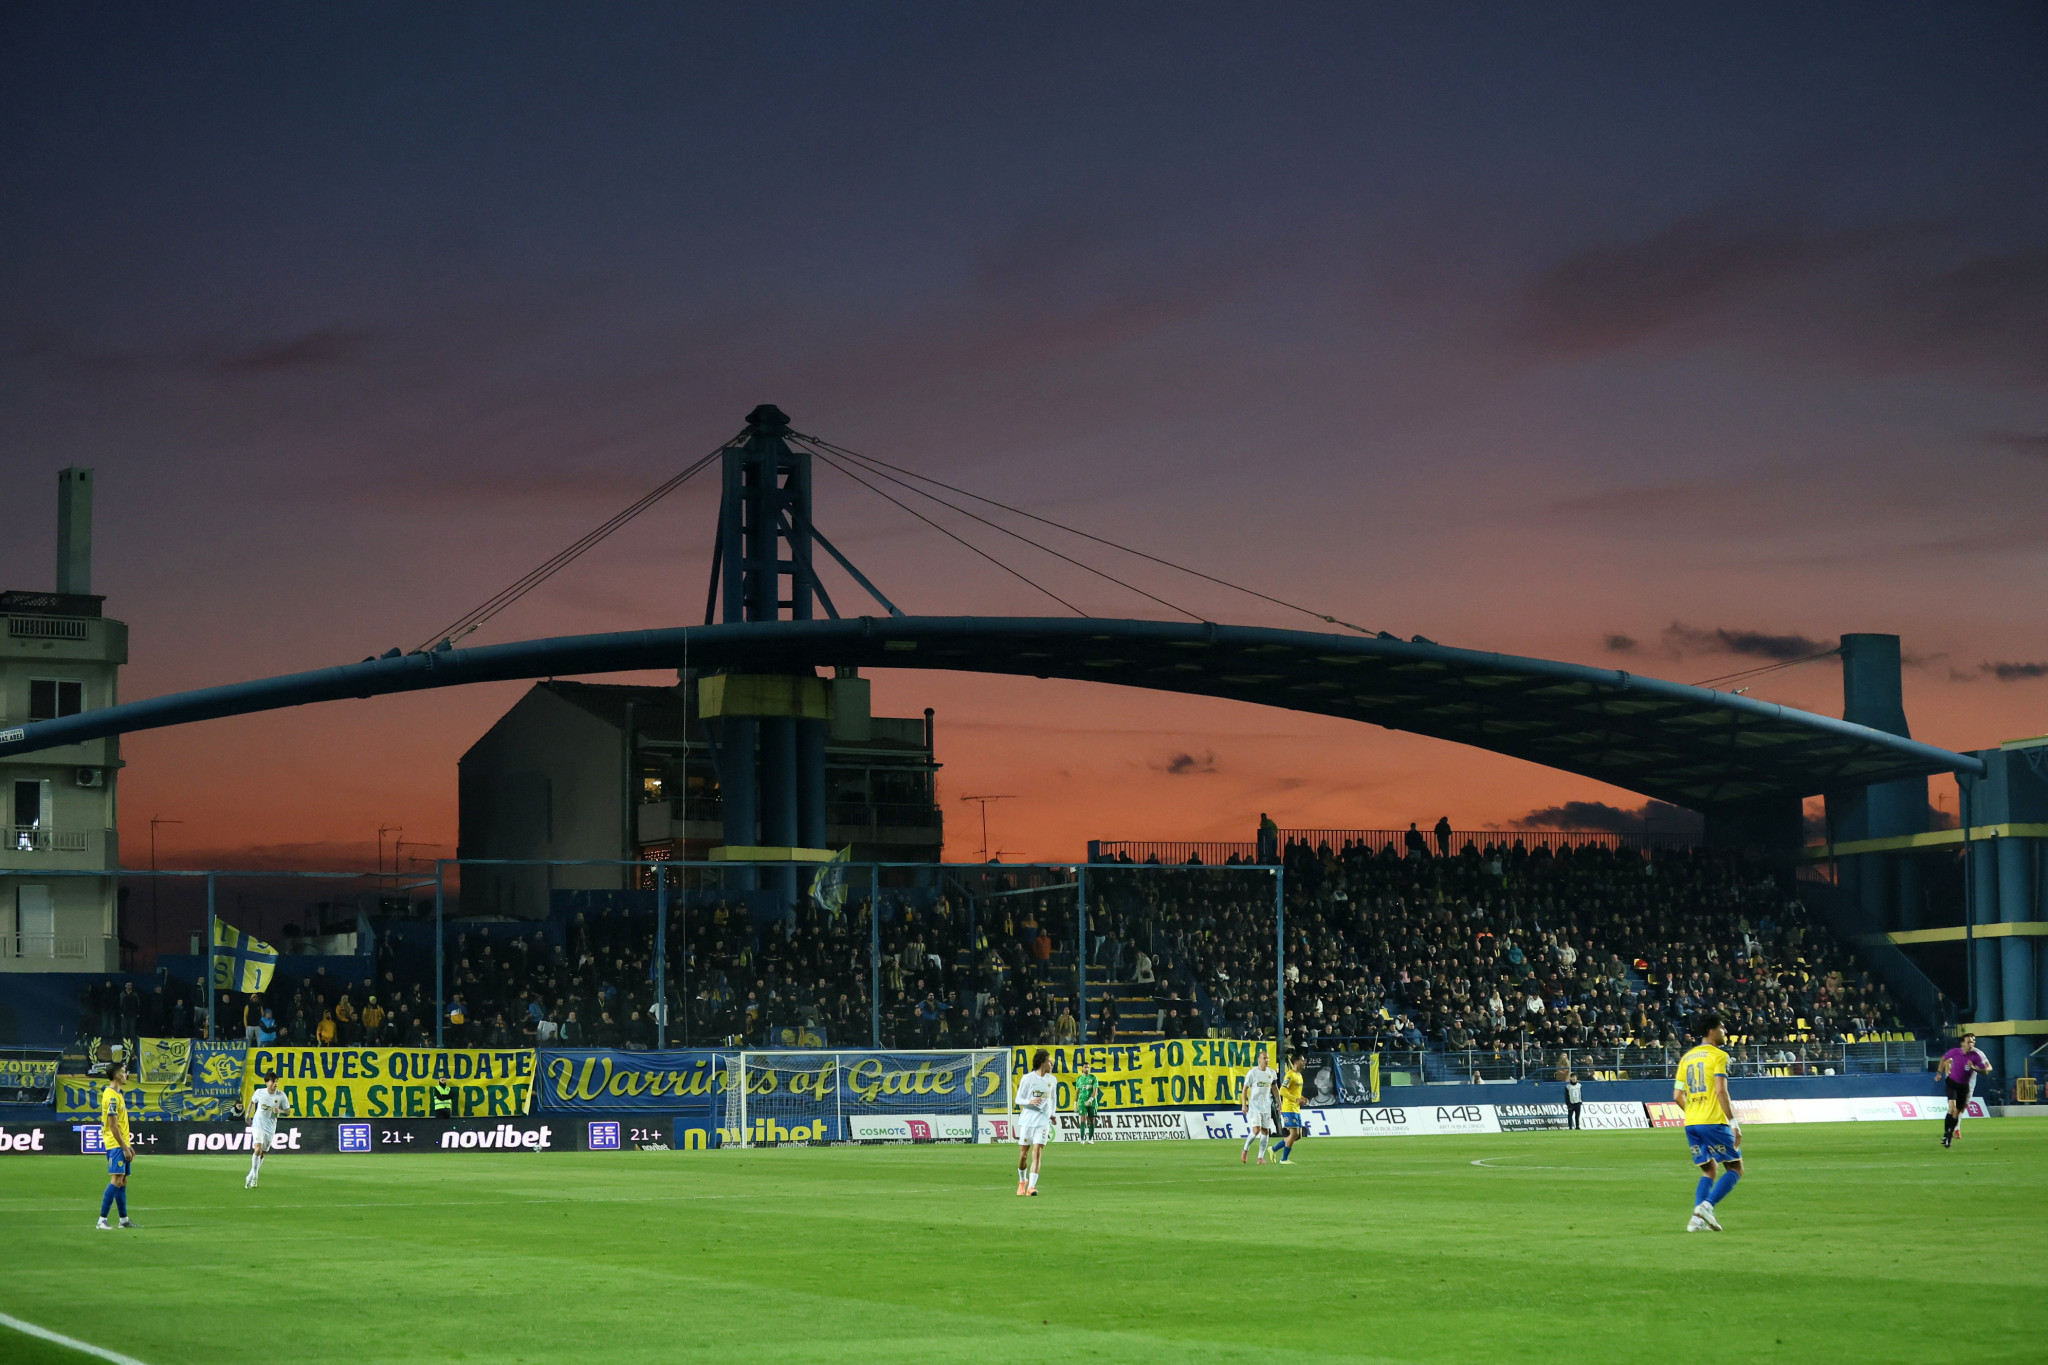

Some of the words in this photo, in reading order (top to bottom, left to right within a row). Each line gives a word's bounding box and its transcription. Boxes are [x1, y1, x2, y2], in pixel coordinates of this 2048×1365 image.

[195, 1041, 247, 1051] ANTINAZI
[254, 1050, 380, 1079] CHAVES
[388, 1051, 532, 1081] QUADATE
[1012, 1046, 1142, 1075] ΑΛΑΞΤΕ
[1149, 1041, 1184, 1069] ΤΟ
[547, 1057, 779, 1101] Warriors
[789, 1060, 836, 1101] of
[847, 1058, 956, 1102] Gate
[964, 1055, 1001, 1098] 6
[1686, 1062, 1707, 1094] 41
[1151, 1075, 1205, 1103] ΤΟΝ
[1360, 1108, 1407, 1125] A4B
[1436, 1106, 1482, 1123] A4B
[1496, 1105, 1507, 1117] K.
[1506, 1103, 1569, 1116] SARAGANIDAS
[1060, 1115, 1113, 1130] ΕΝΣΗ
[1116, 1114, 1181, 1129] ΑΓΡΙΝΙΟΥ
[187, 1126, 301, 1151] noviet
[381, 1130, 415, 1144] 21+
[441, 1124, 552, 1149] novibet
[630, 1128, 662, 1141] 21+
[859, 1127, 907, 1136] COSMOTE
[945, 1128, 992, 1136] COSMTE
[1206, 1123, 1234, 1139] taf
